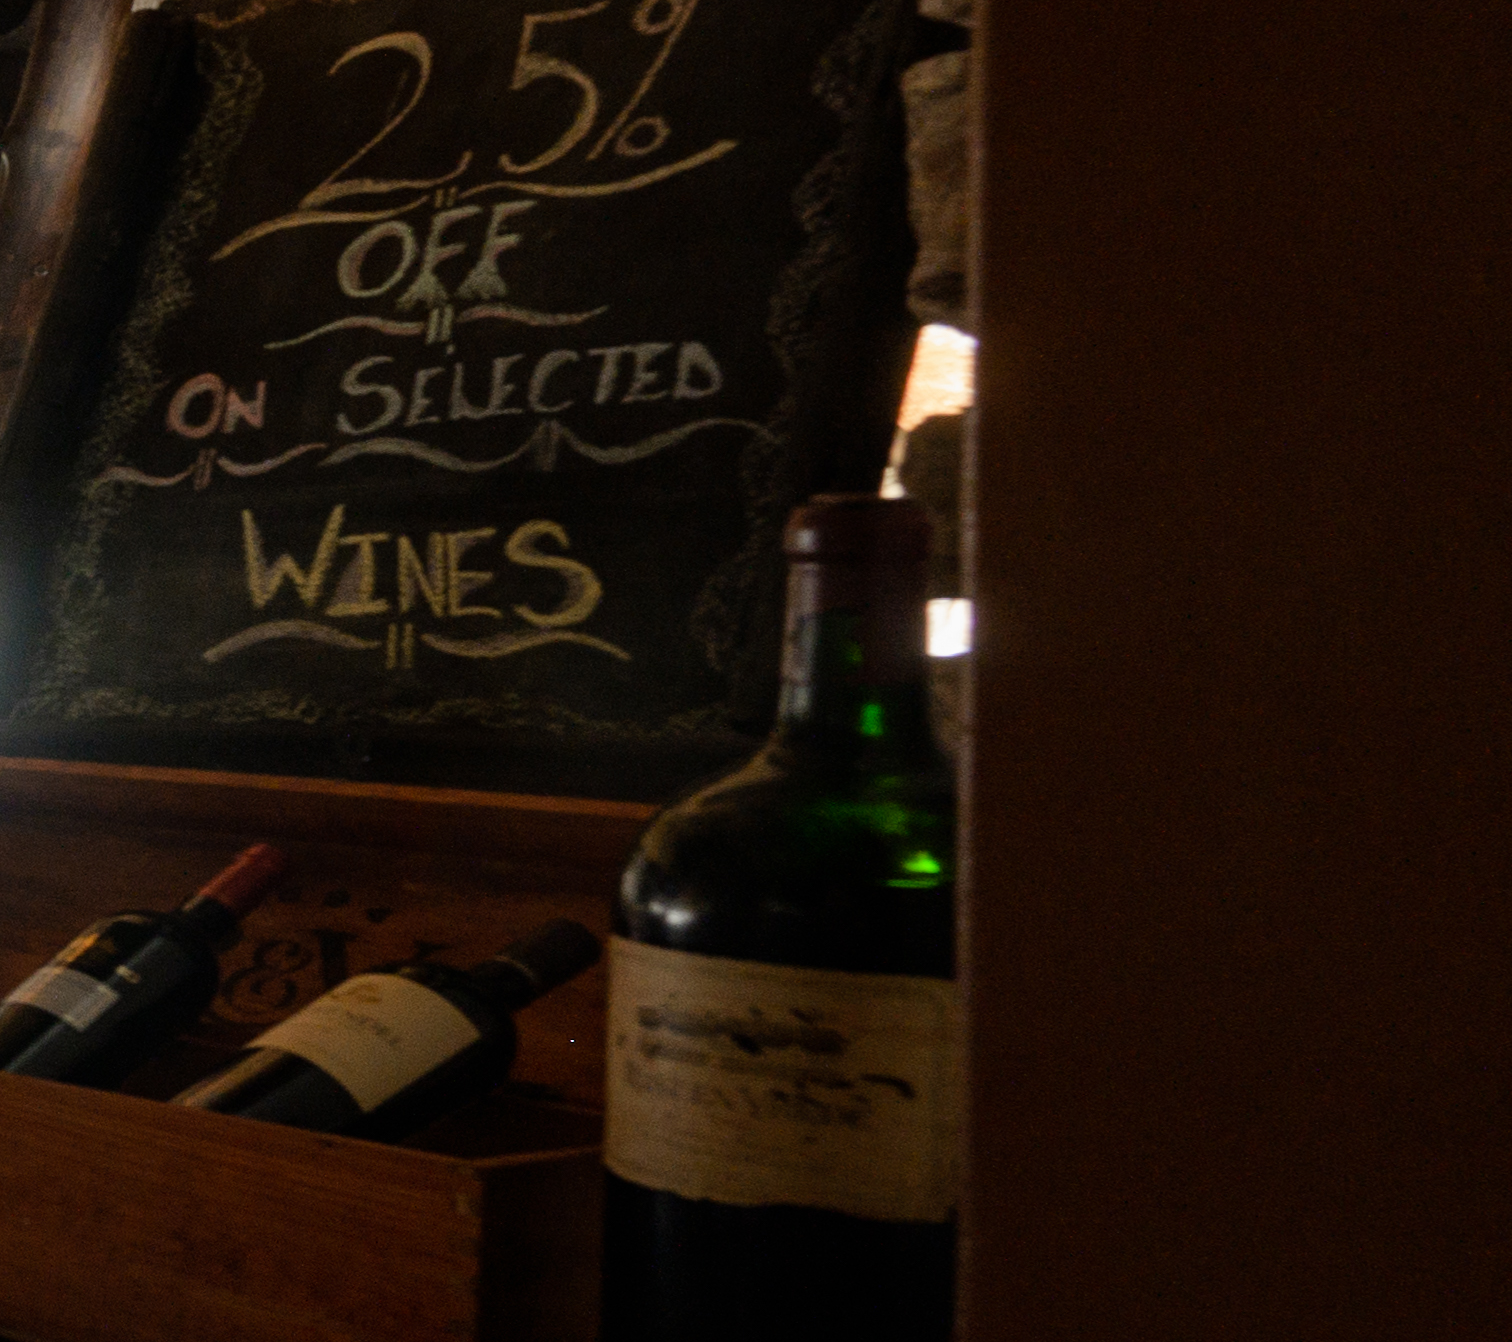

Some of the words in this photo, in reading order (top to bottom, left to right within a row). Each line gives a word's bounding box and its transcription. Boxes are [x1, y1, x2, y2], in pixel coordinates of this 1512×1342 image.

[337, 200, 538, 312] OFF
[166, 372, 265, 439] ON
[335, 340, 724, 436] SELECTED
[241, 503, 603, 628] WINES
